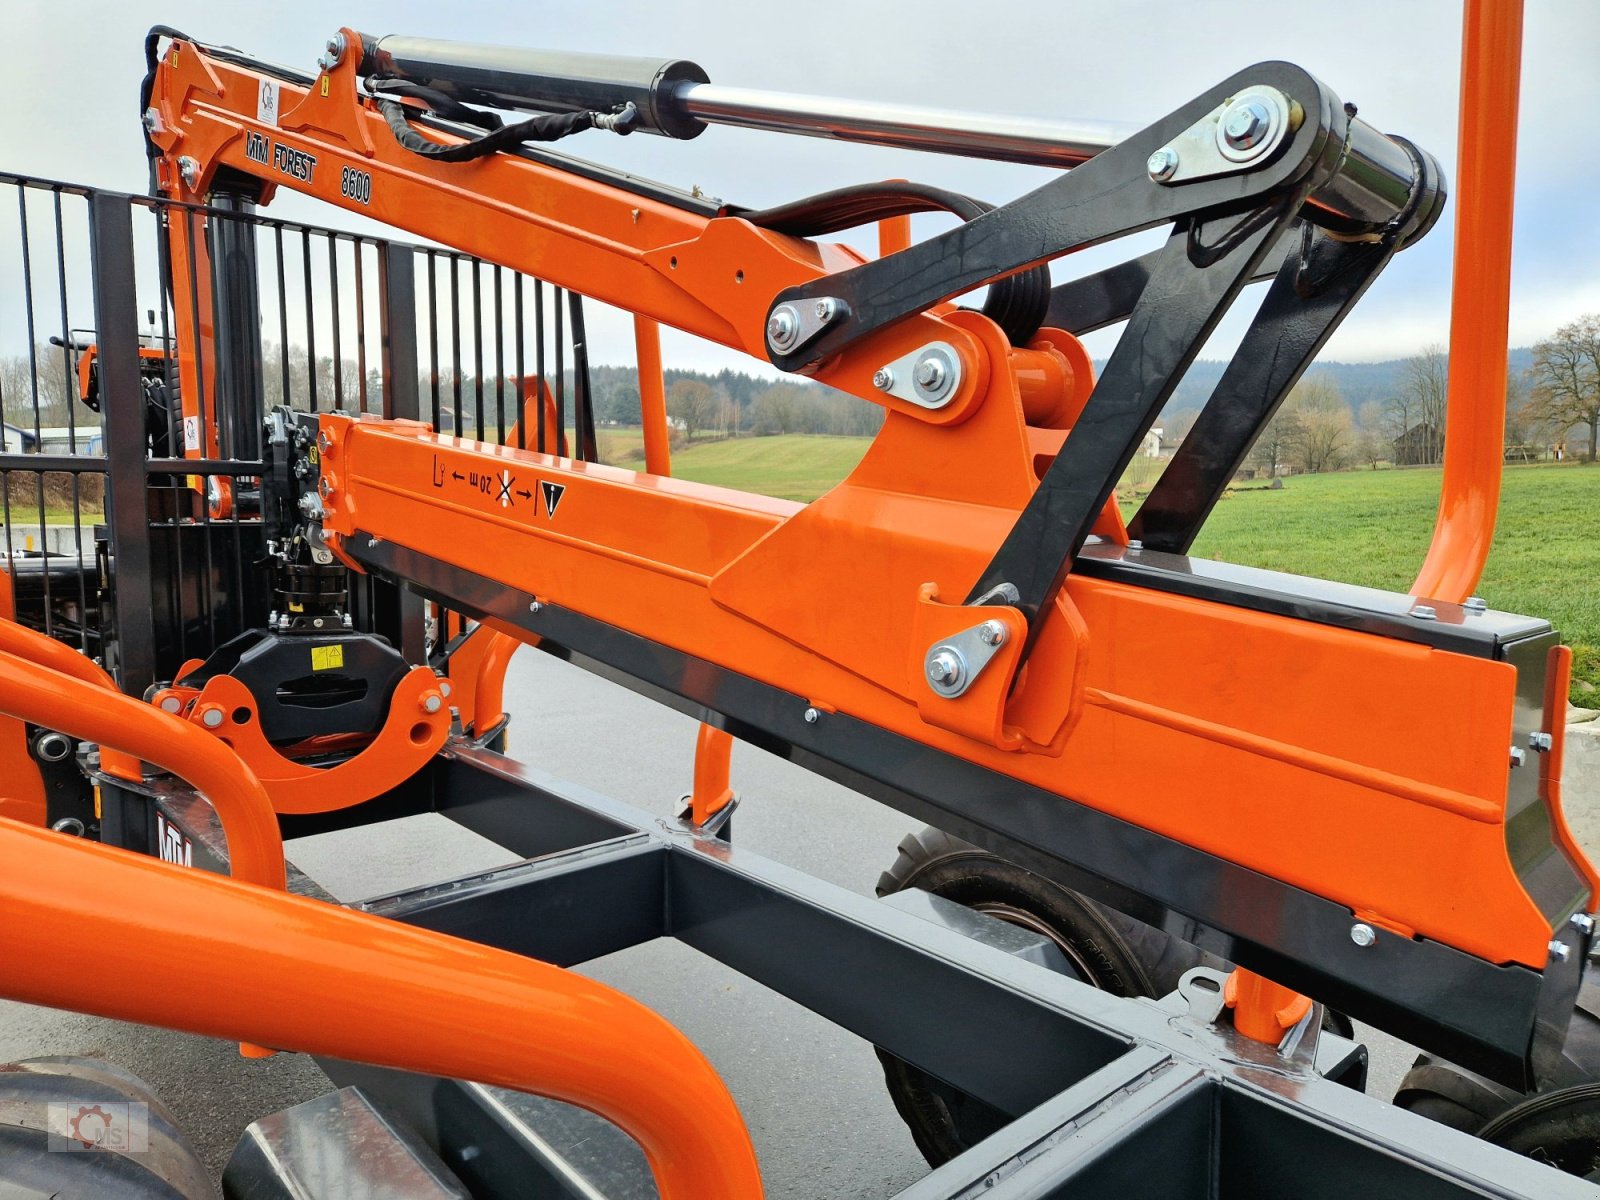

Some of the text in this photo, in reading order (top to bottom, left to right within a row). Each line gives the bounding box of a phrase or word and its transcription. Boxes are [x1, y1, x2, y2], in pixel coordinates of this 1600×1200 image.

[246, 130, 371, 205] MTM FOREST 8600
